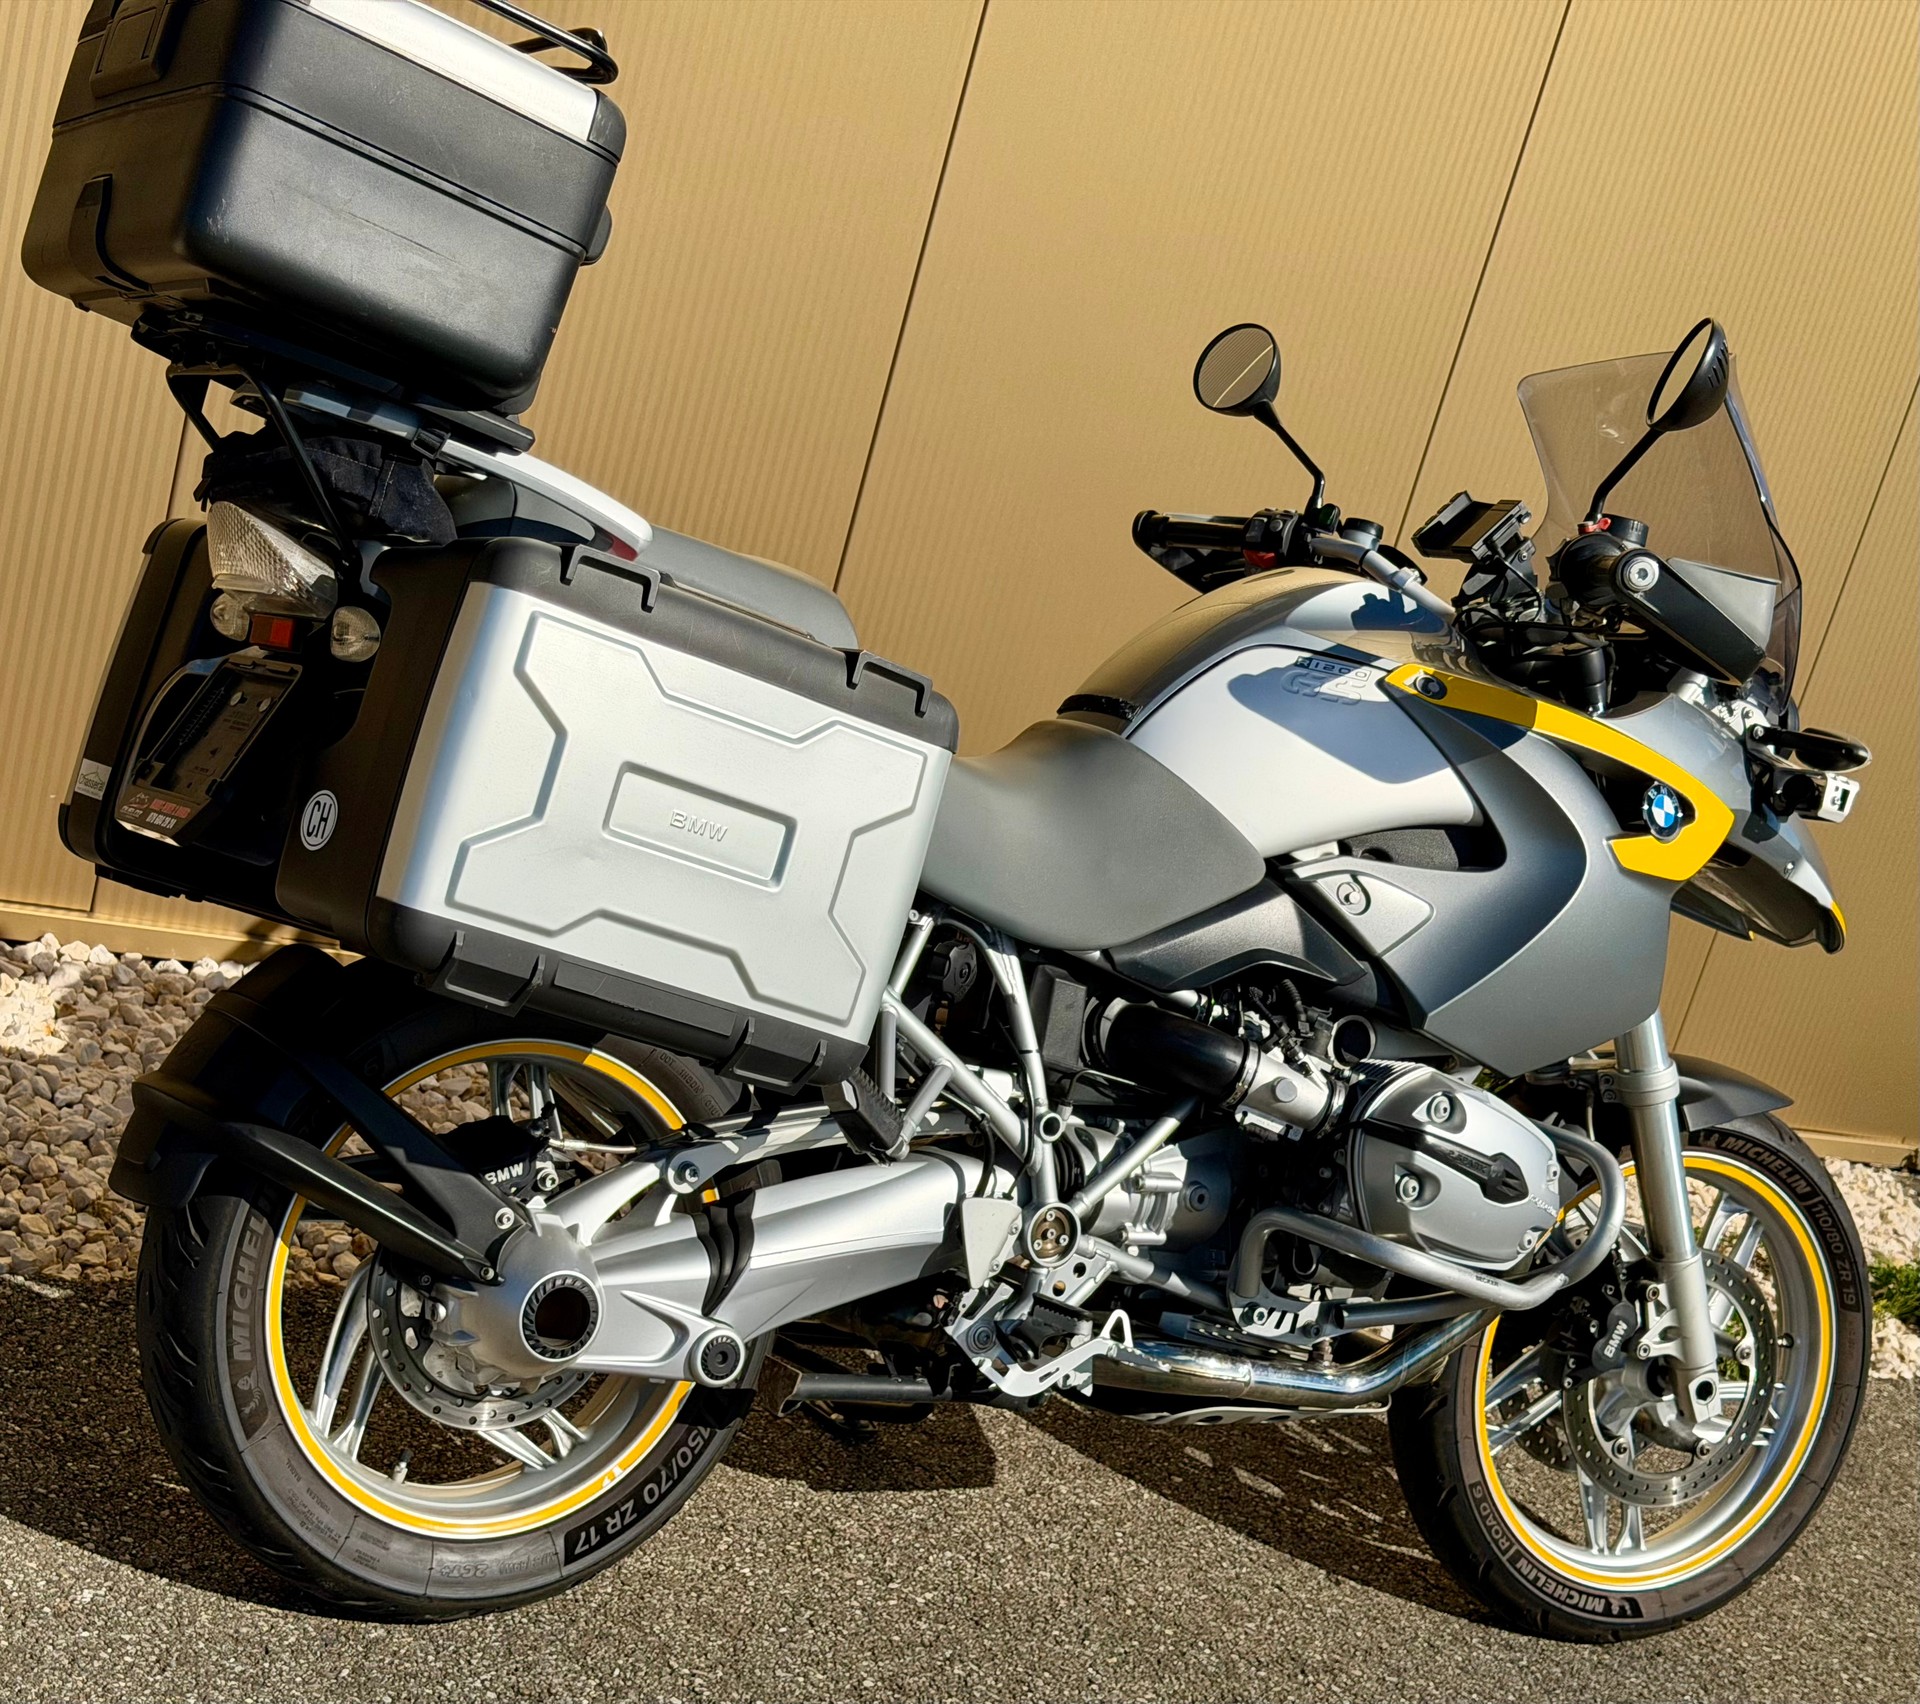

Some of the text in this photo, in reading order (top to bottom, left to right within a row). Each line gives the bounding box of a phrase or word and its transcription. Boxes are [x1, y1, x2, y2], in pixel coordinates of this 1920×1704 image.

[1281, 670, 1362, 705] GS
[306, 800, 332, 839] CH
[669, 808, 729, 842] BMW
[1720, 1136, 1812, 1198] MICHELIN
[1810, 1203, 1844, 1254] 110/80
[1836, 1258, 1852, 1283] ZR
[1843, 1287, 1857, 1306] 19
[1604, 1320, 1628, 1359] BMW
[574, 1426, 711, 1555] 150/70 ZR 17
[1472, 1485, 1606, 1613] MICHELIN ROAD 6
[440, 1563, 490, 1579] 2CT+
